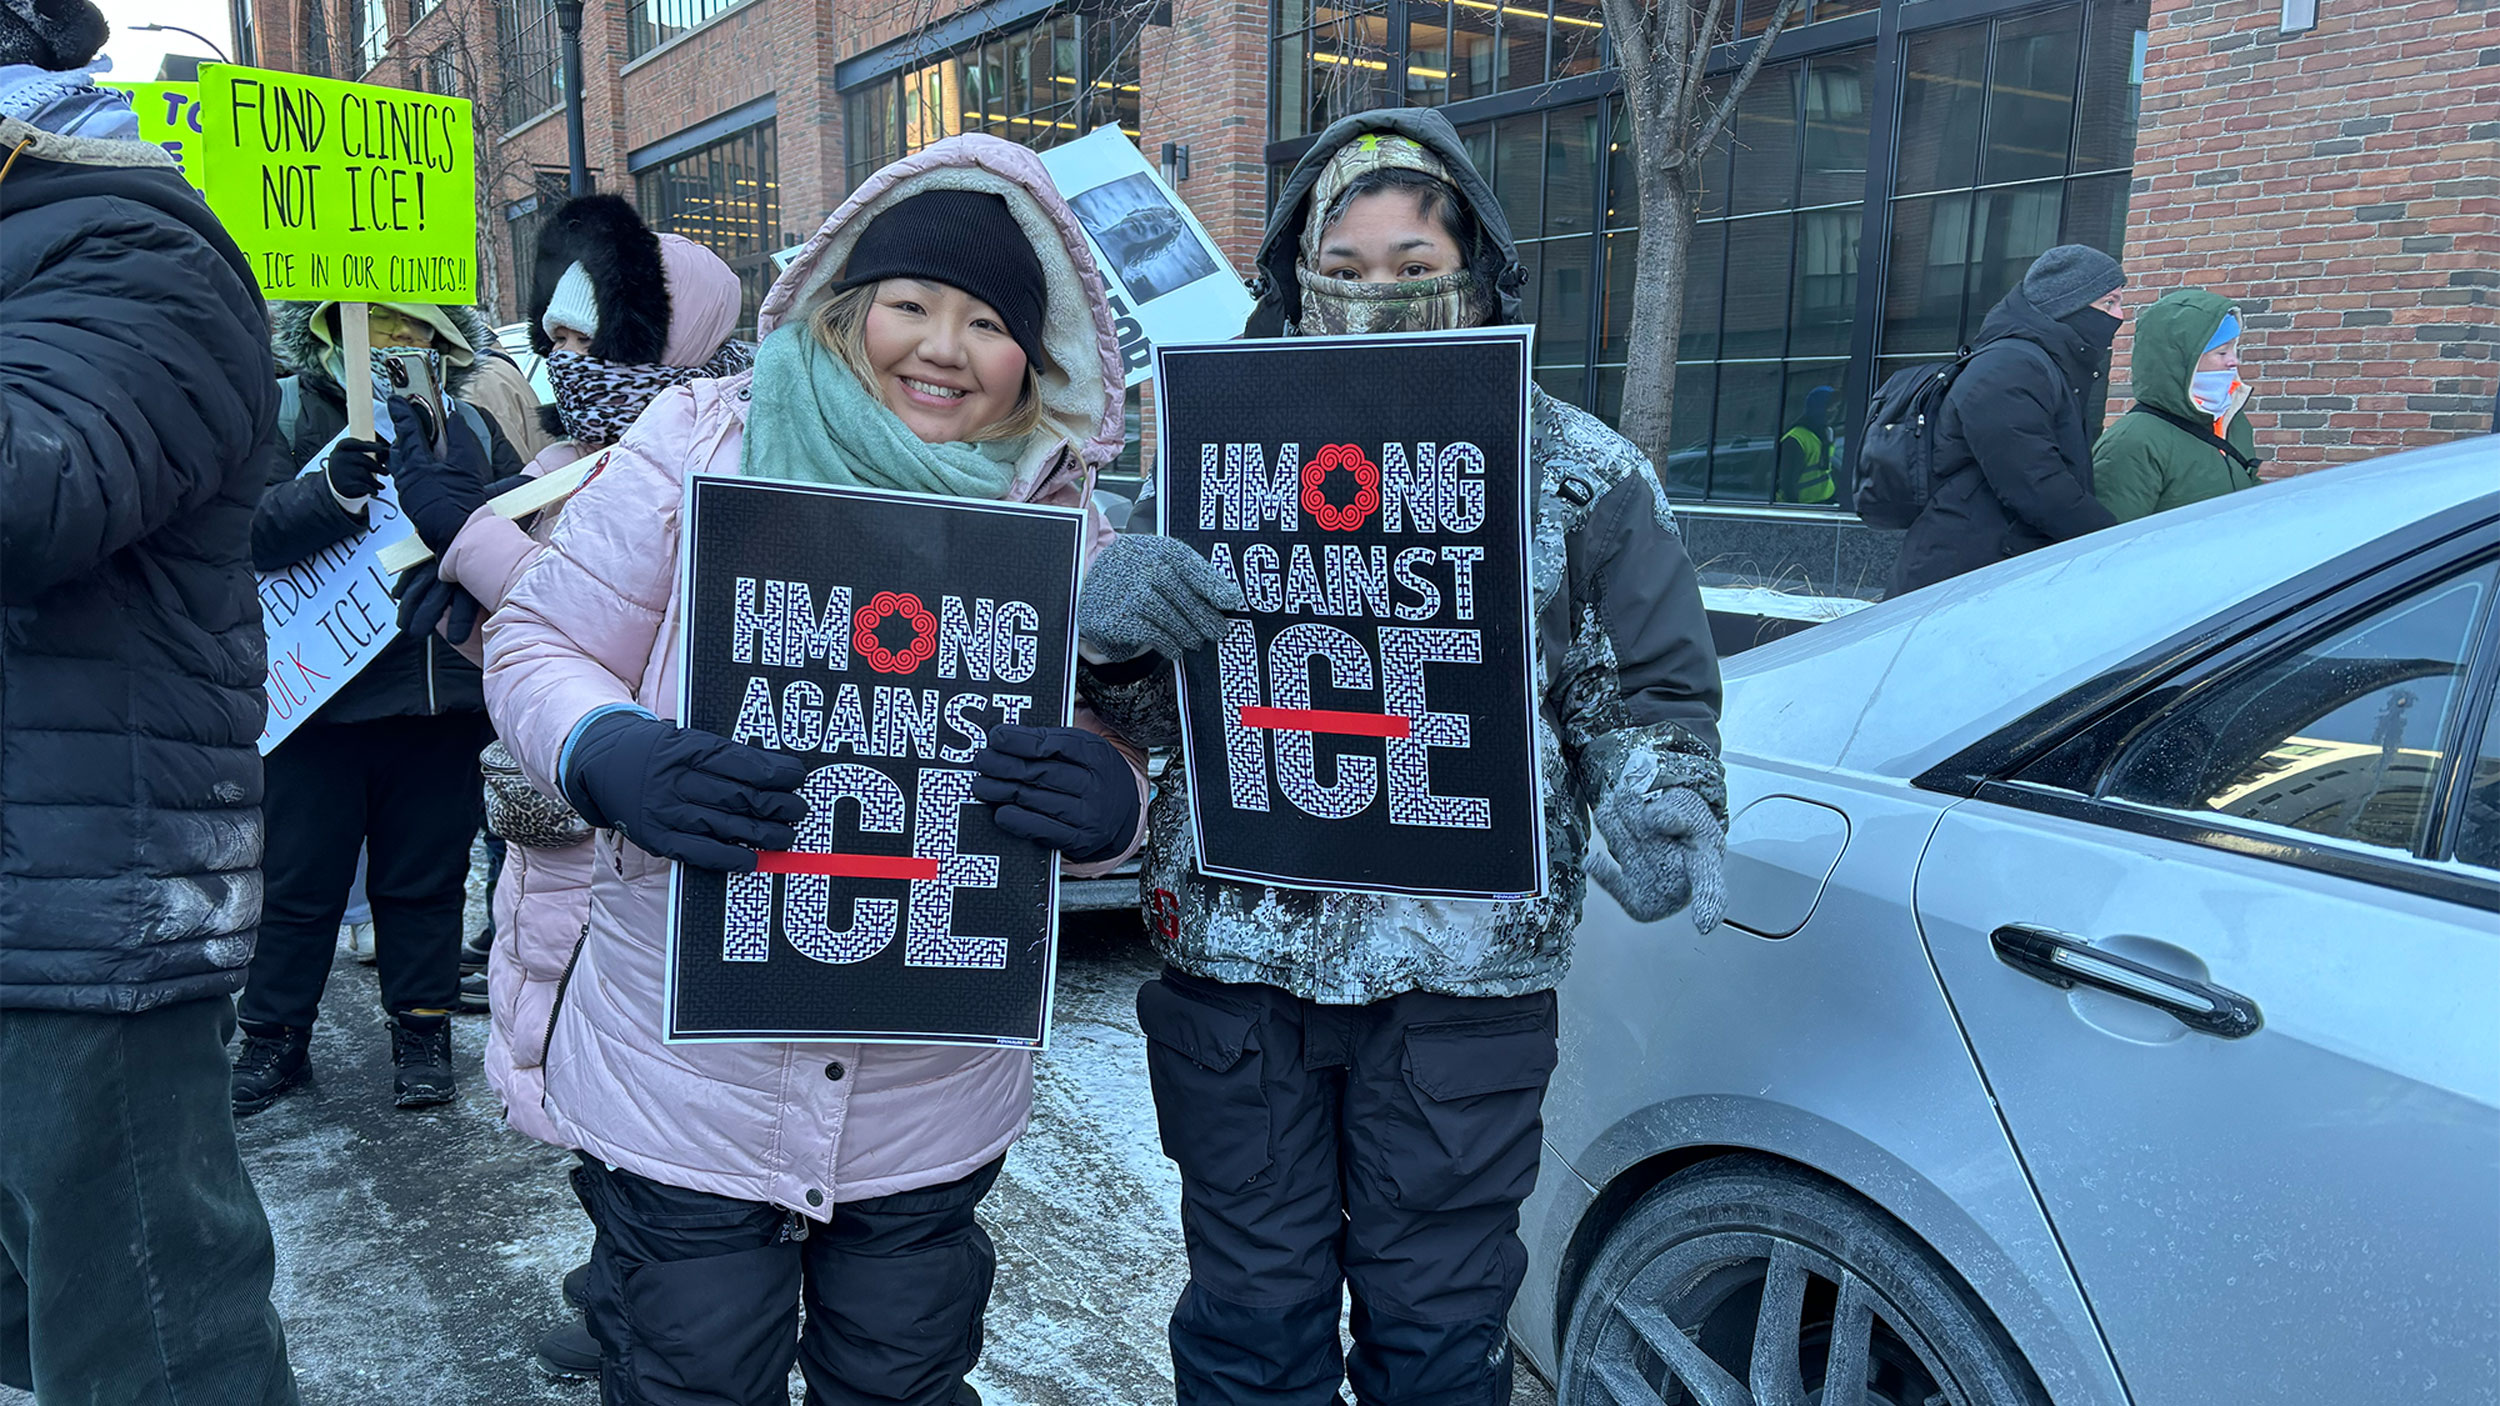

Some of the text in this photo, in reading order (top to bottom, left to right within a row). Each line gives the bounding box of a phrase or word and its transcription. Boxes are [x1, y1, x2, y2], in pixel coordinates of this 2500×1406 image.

[231, 79, 456, 174] FUND CLINICS
[262, 164, 321, 230] NOT
[263, 252, 296, 290] ICE
[311, 253, 329, 289] IN
[343, 254, 380, 290] OUR
[390, 255, 467, 293] CLINICS!!
[1200, 441, 1485, 534] HMONG
[1210, 542, 1485, 621] AGAINST
[732, 576, 1041, 684] HMONG
[263, 642, 332, 738] UCK
[731, 676, 1033, 764] AGAINST
[1217, 618, 1492, 830] ICE
